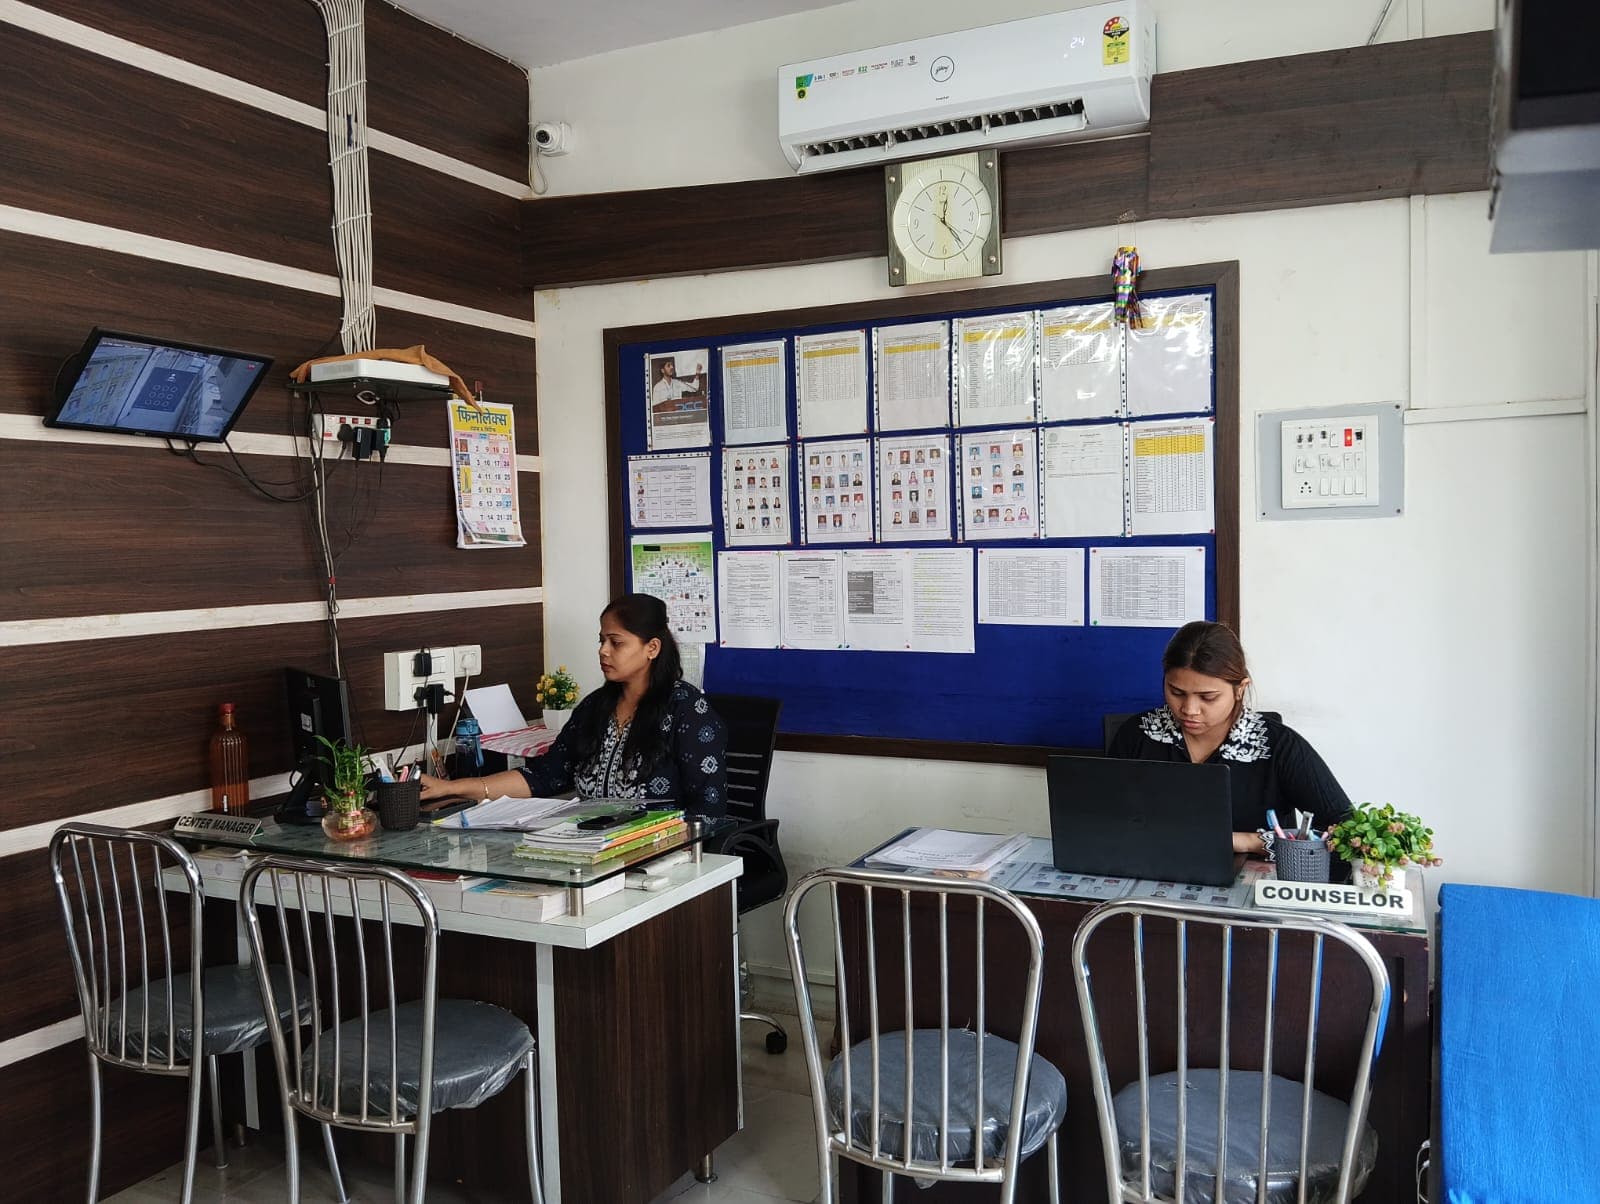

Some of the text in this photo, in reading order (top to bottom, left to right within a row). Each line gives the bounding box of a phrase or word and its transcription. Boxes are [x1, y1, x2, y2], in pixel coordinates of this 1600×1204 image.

[1070, 36, 1085, 49] 24
[939, 185, 947, 196] 12
[968, 210, 974, 222] 3
[914, 219, 919, 230] 9
[942, 244, 947, 255] 6
[178, 815, 256, 834] CENTER MANAGER
[1262, 886, 1405, 909] COUNSELOR
